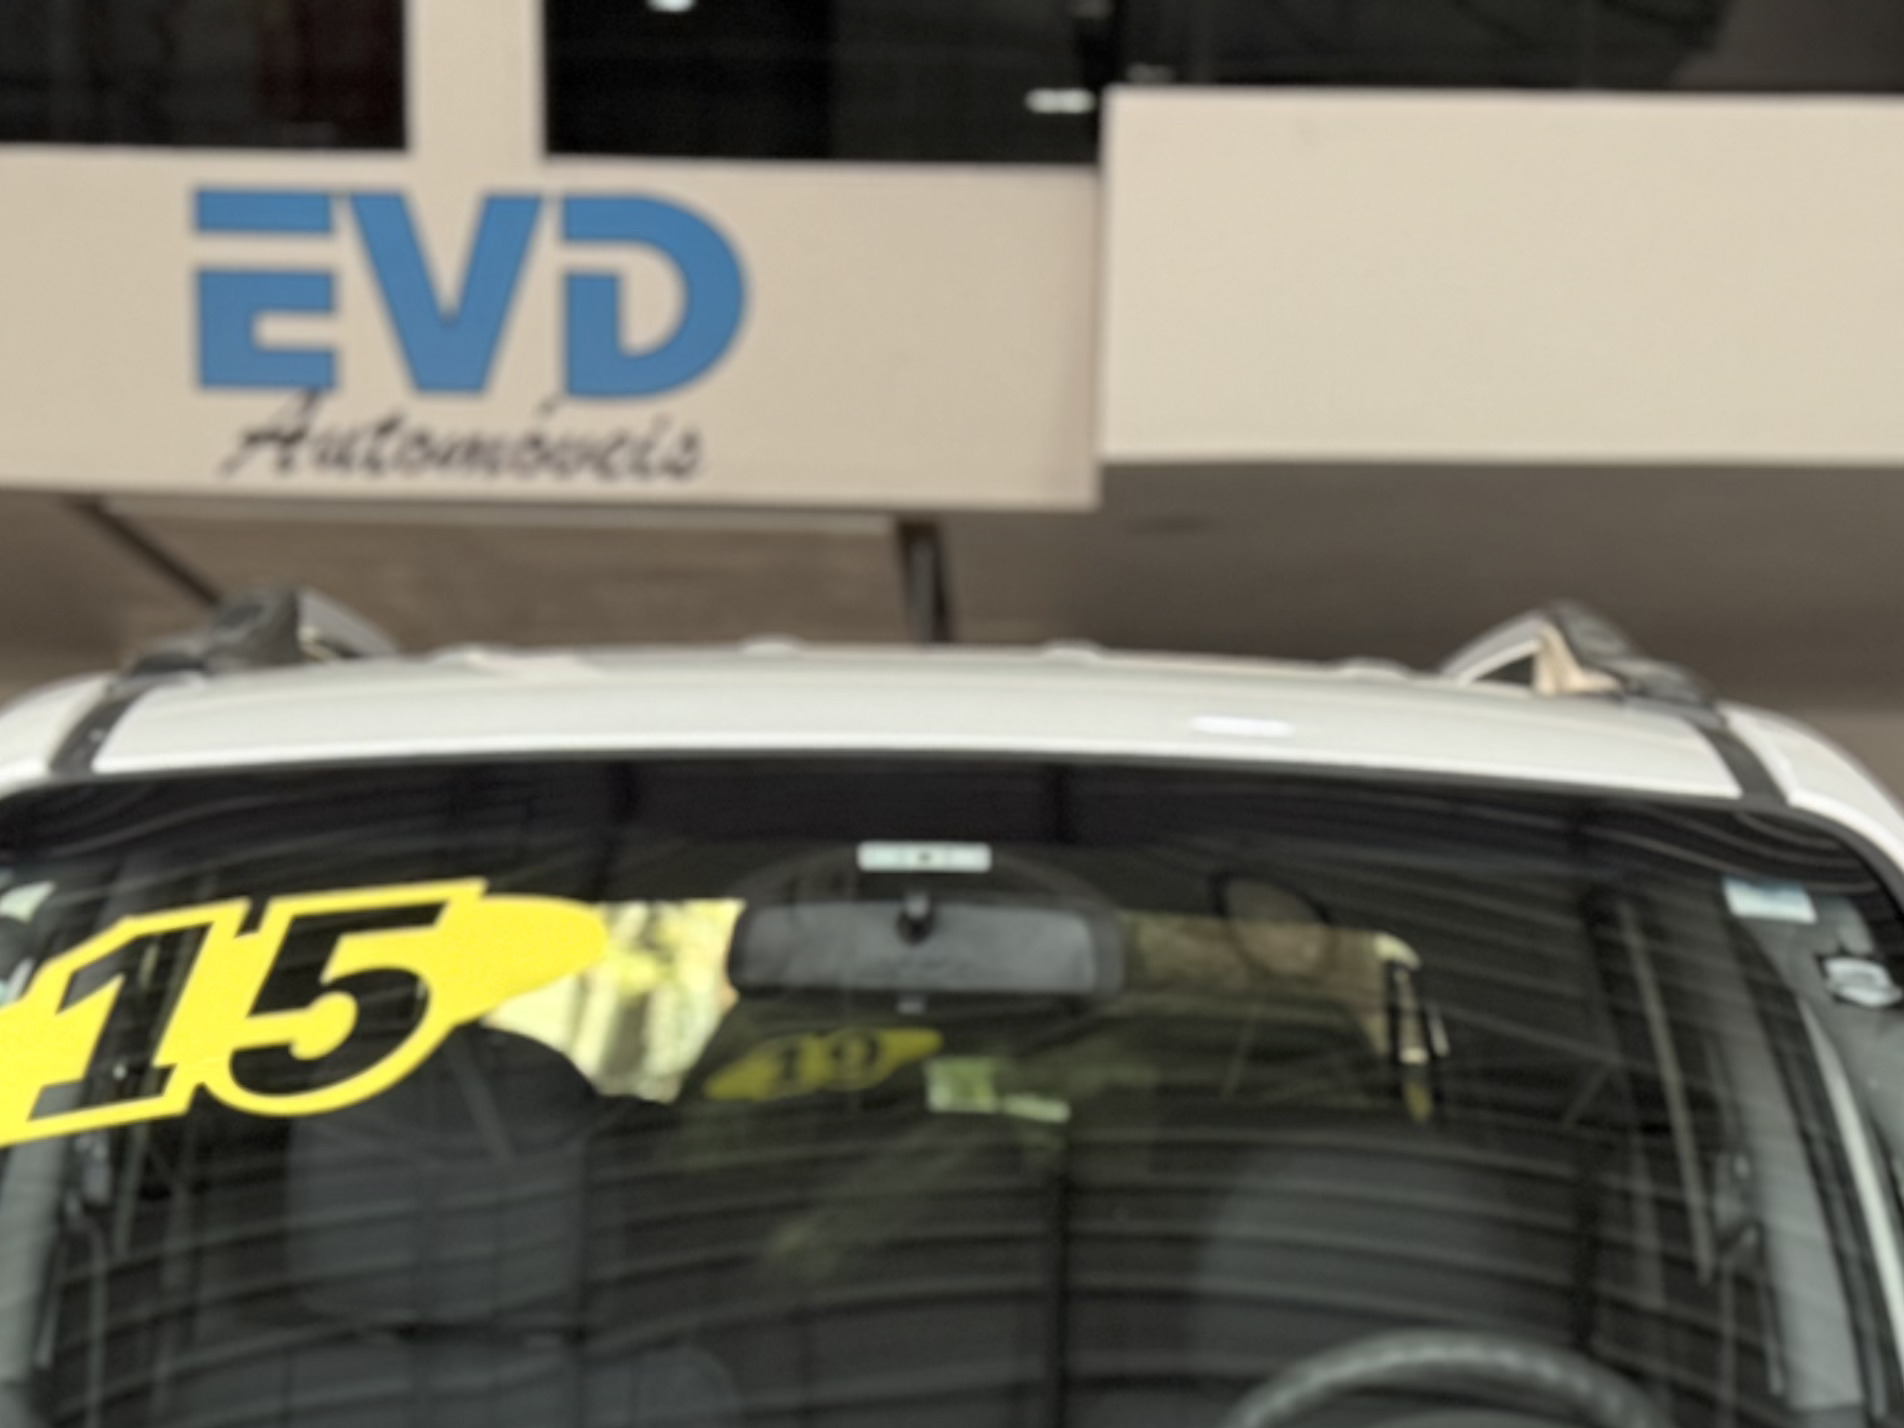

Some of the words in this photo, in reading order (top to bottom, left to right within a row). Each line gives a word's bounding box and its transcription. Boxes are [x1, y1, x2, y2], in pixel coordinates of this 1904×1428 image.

[193, 186, 750, 402] EVD
[220, 388, 701, 479] Automóveis
[26, 903, 470, 1122] 15
